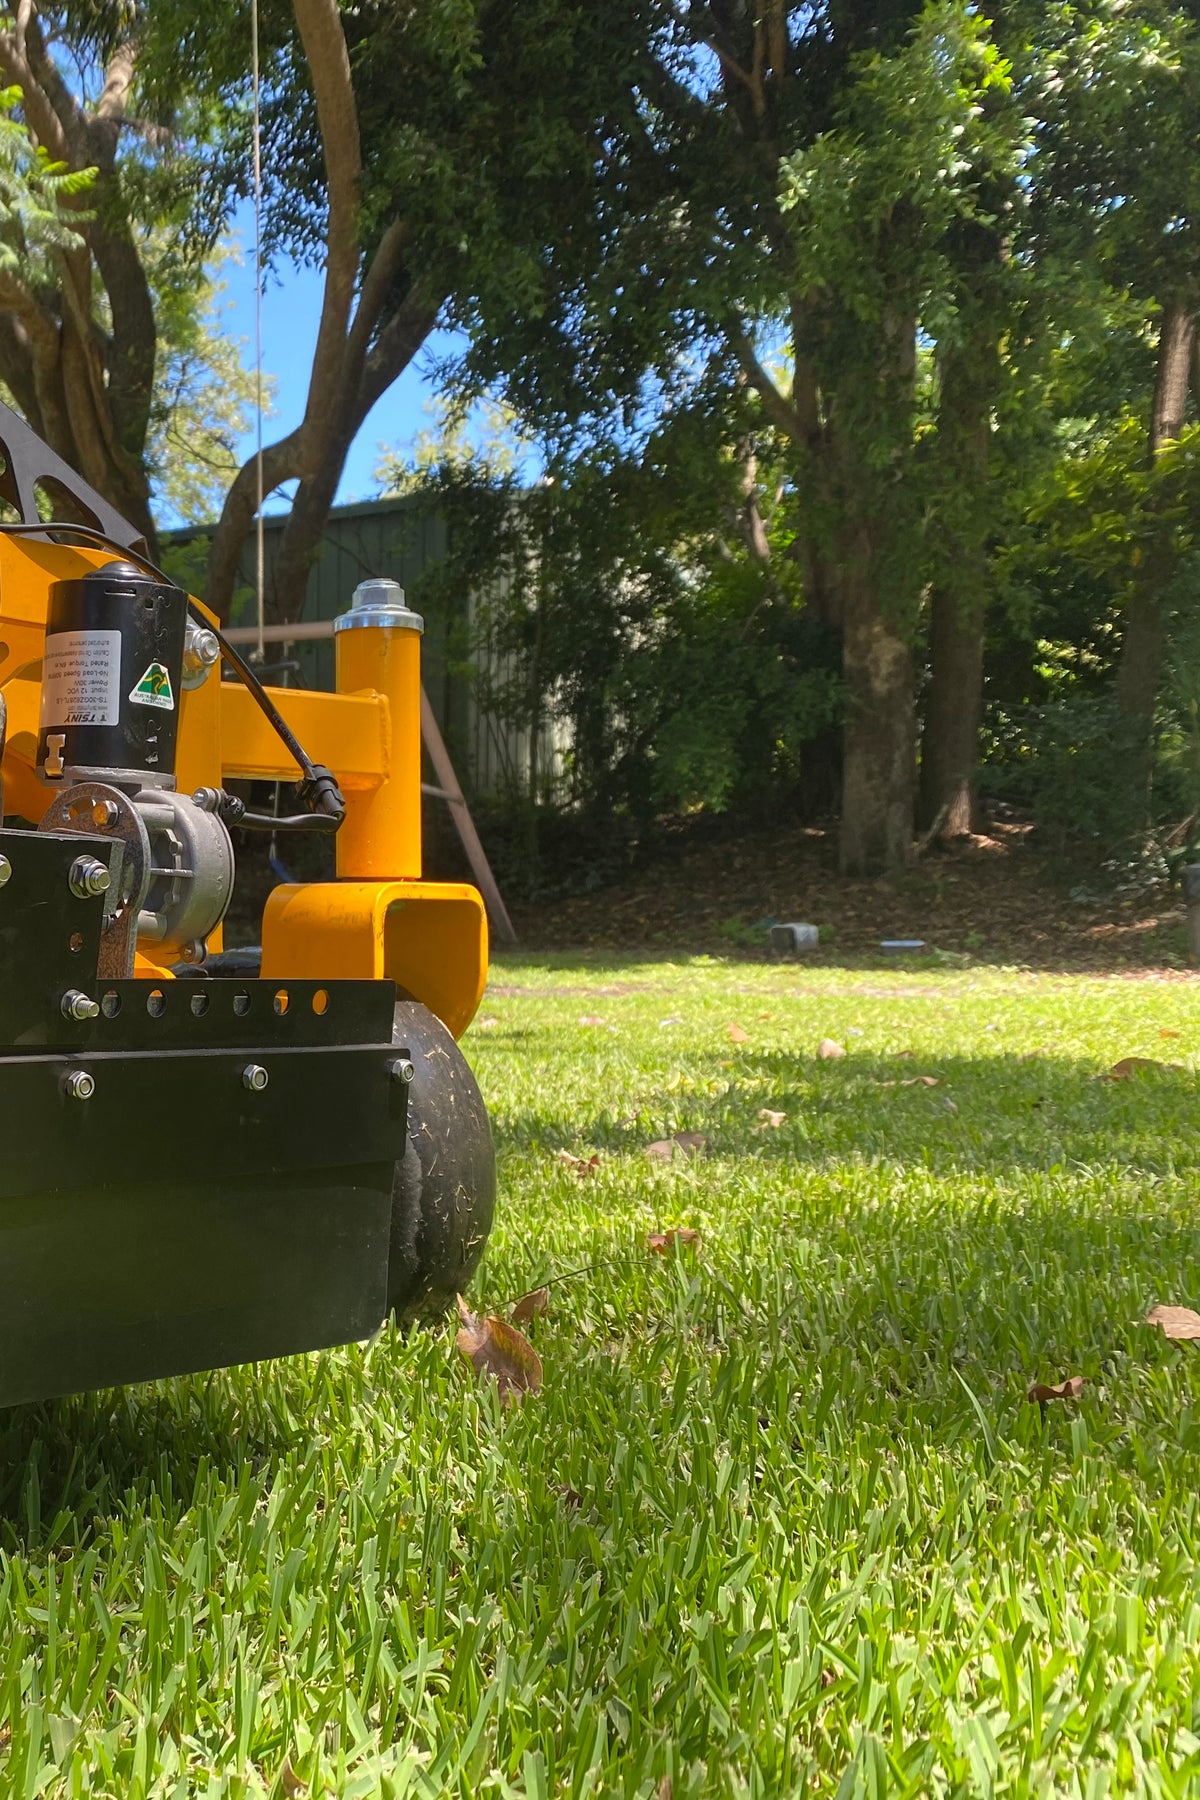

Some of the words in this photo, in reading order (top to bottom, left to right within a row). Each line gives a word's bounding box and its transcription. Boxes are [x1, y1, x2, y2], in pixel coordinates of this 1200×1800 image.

[69, 660, 88, 668] Torque
[63, 670, 81, 678] Speed
[83, 670, 108, 678] No-Load
[64, 713, 95, 723] TSINY
